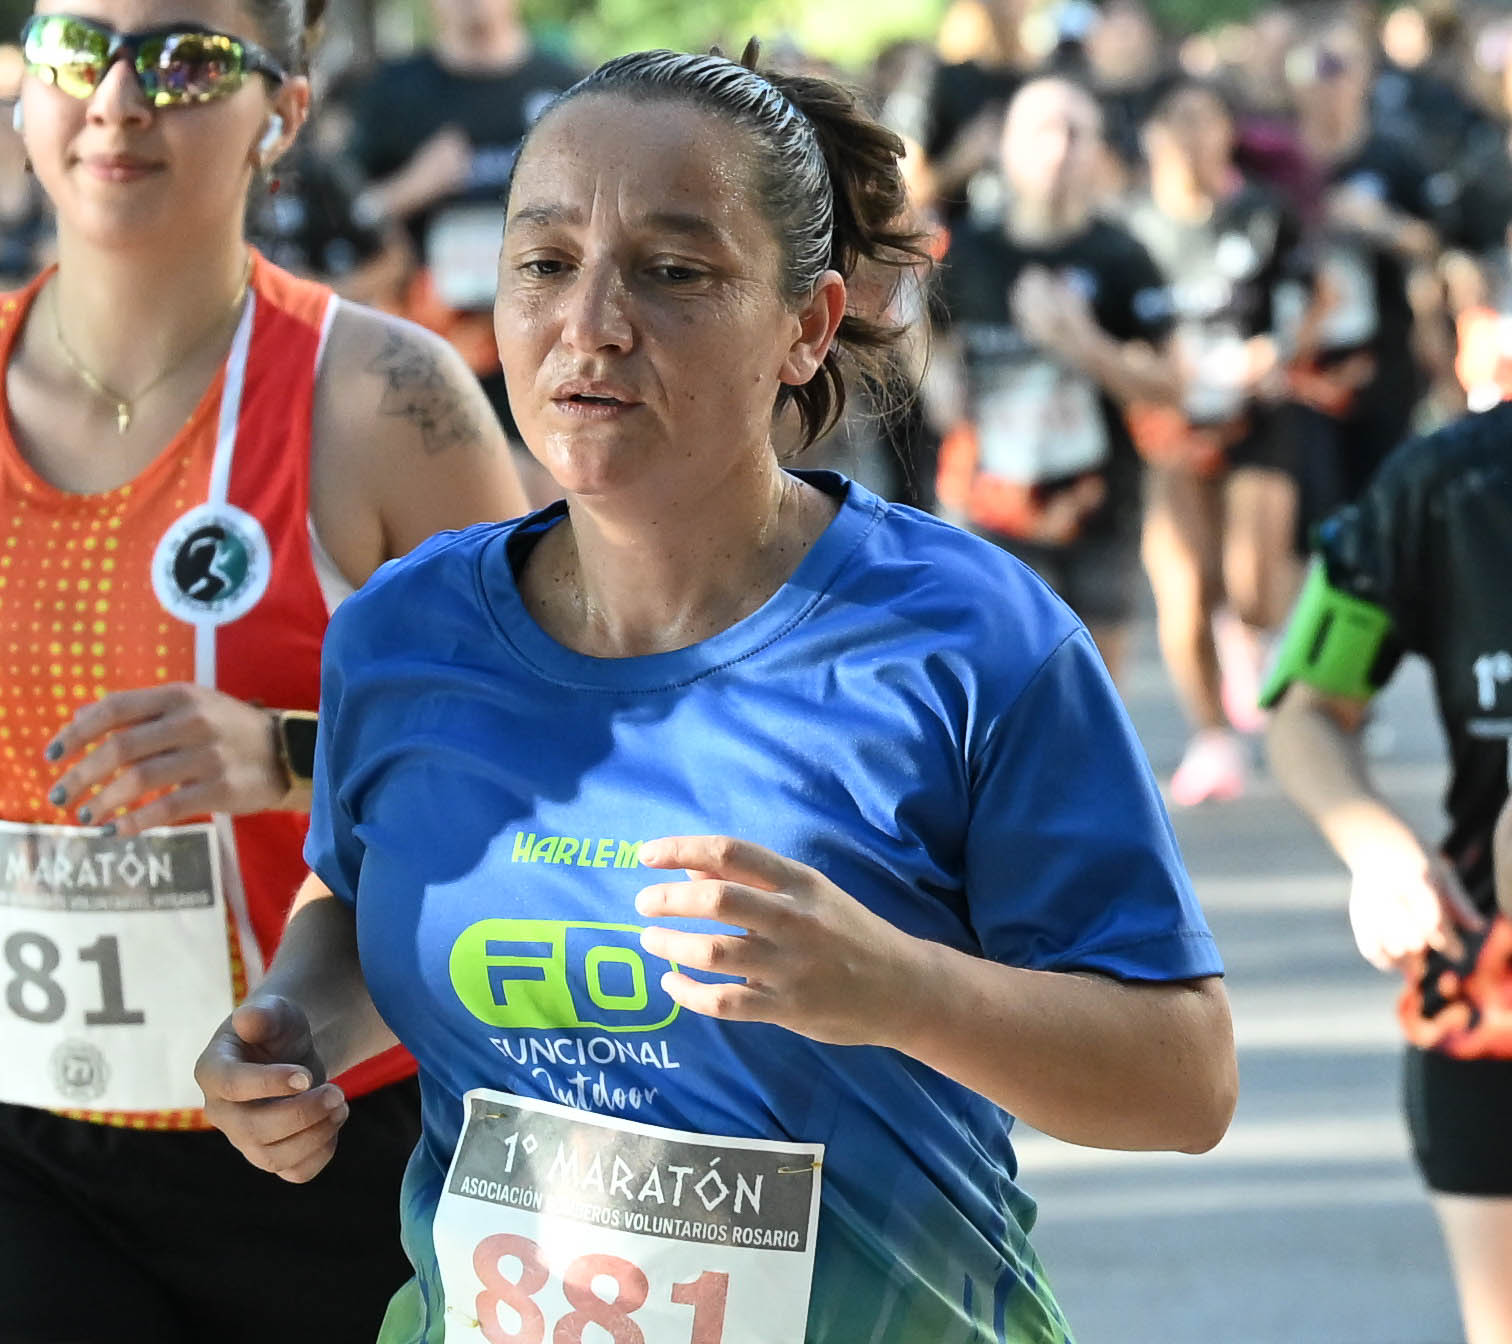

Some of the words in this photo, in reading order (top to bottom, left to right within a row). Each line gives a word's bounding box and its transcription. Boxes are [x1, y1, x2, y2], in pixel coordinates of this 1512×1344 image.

[5, 842, 173, 888] MARATÓN
[511, 831, 644, 869] HARLEM
[3, 931, 146, 1026] 81
[461, 1175, 543, 1210] ASOCIACIÓN
[624, 1211, 728, 1243] VOLUNTARIOS
[731, 1226, 799, 1249] ROSARIO
[547, 1139, 764, 1216] MARATÓN
